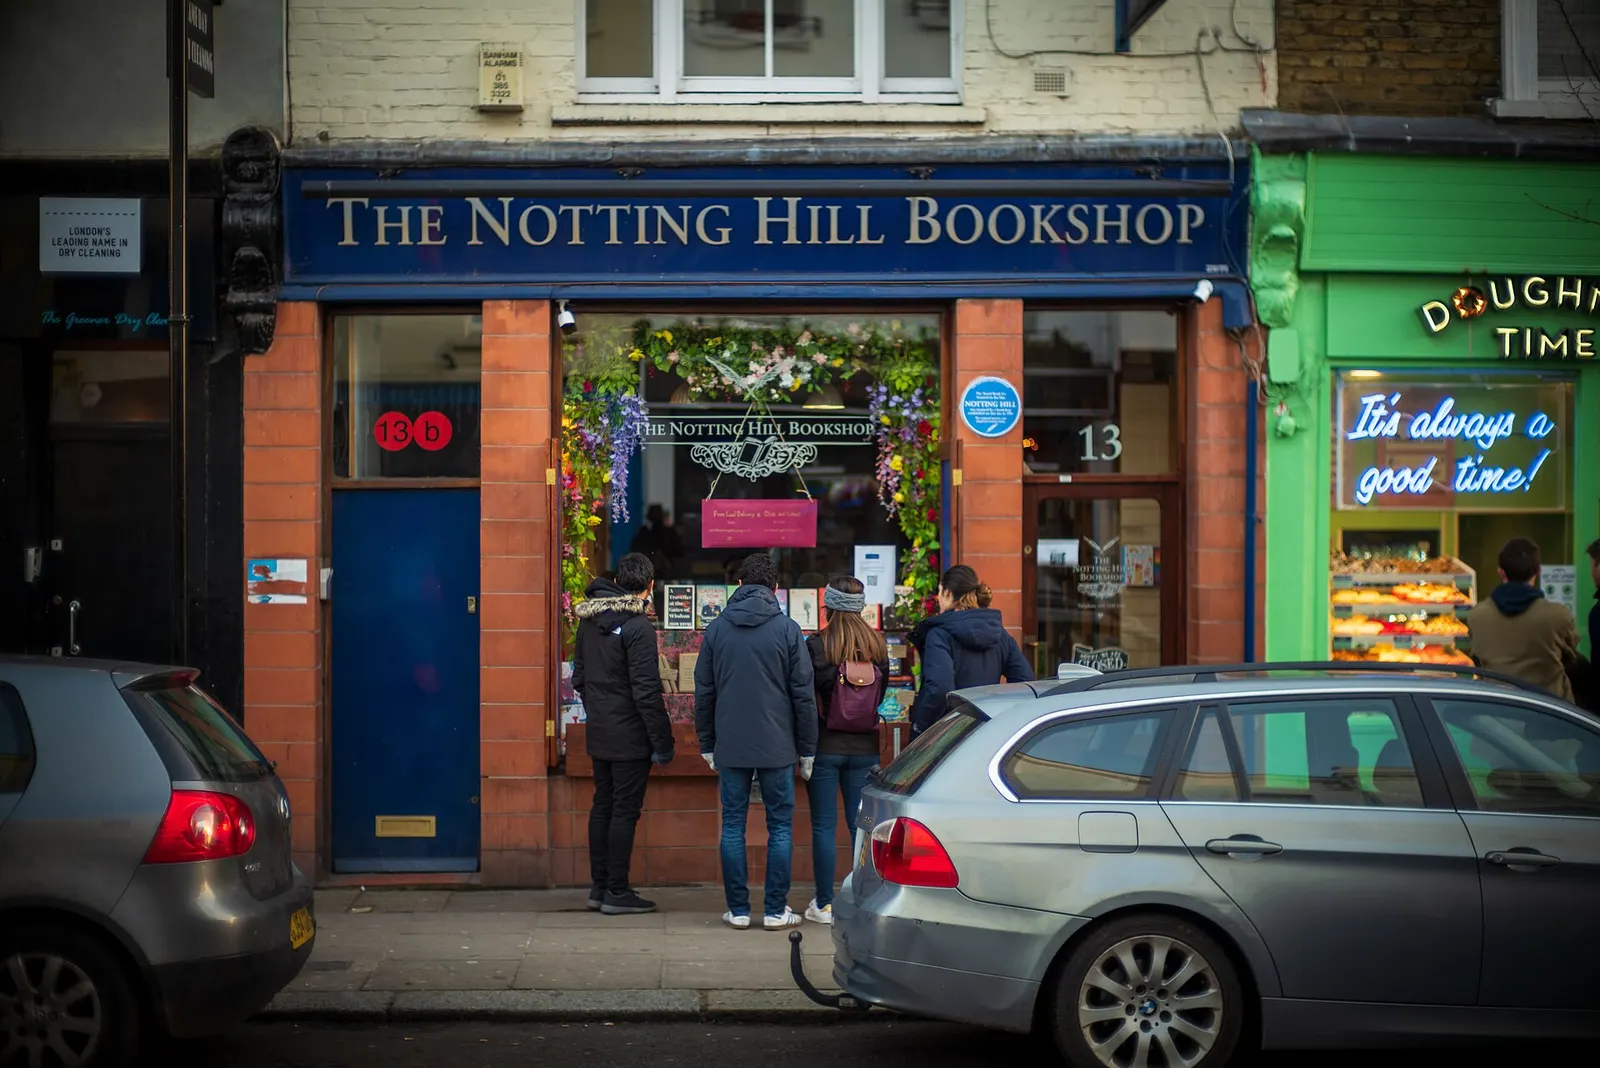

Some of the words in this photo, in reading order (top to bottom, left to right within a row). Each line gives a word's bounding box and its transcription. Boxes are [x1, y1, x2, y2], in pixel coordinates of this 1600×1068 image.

[484, 59, 517, 67] ALARMS
[326, 197, 447, 246] THE
[465, 197, 732, 247] NOTTING
[754, 196, 885, 245] HILL
[905, 196, 1205, 245] BOOKSHOP
[69, 227, 111, 236] LONDON'S
[52, 237, 89, 247] LEADING
[91, 238, 117, 247] NAME
[119, 239, 128, 247] IN
[58, 248, 76, 257] DRY
[78, 249, 121, 257] CLEANING
[41, 310, 61, 324] The
[65, 312, 111, 330] Greener
[114, 313, 143, 332] Dry
[1496, 327, 1596, 359] TIME
[965, 400, 998, 408] NOTTING
[999, 400, 1017, 408] HILL
[670, 421, 744, 436] NOTTING
[748, 421, 785, 436] HILL
[788, 421, 874, 436] BOOKSHOP
[1347, 391, 1402, 440] It's
[1409, 396, 1516, 450] always
[1527, 411, 1555, 439] a
[1078, 424, 1122, 460] 13
[1355, 455, 1438, 506] good
[1454, 448, 1552, 493] time!
